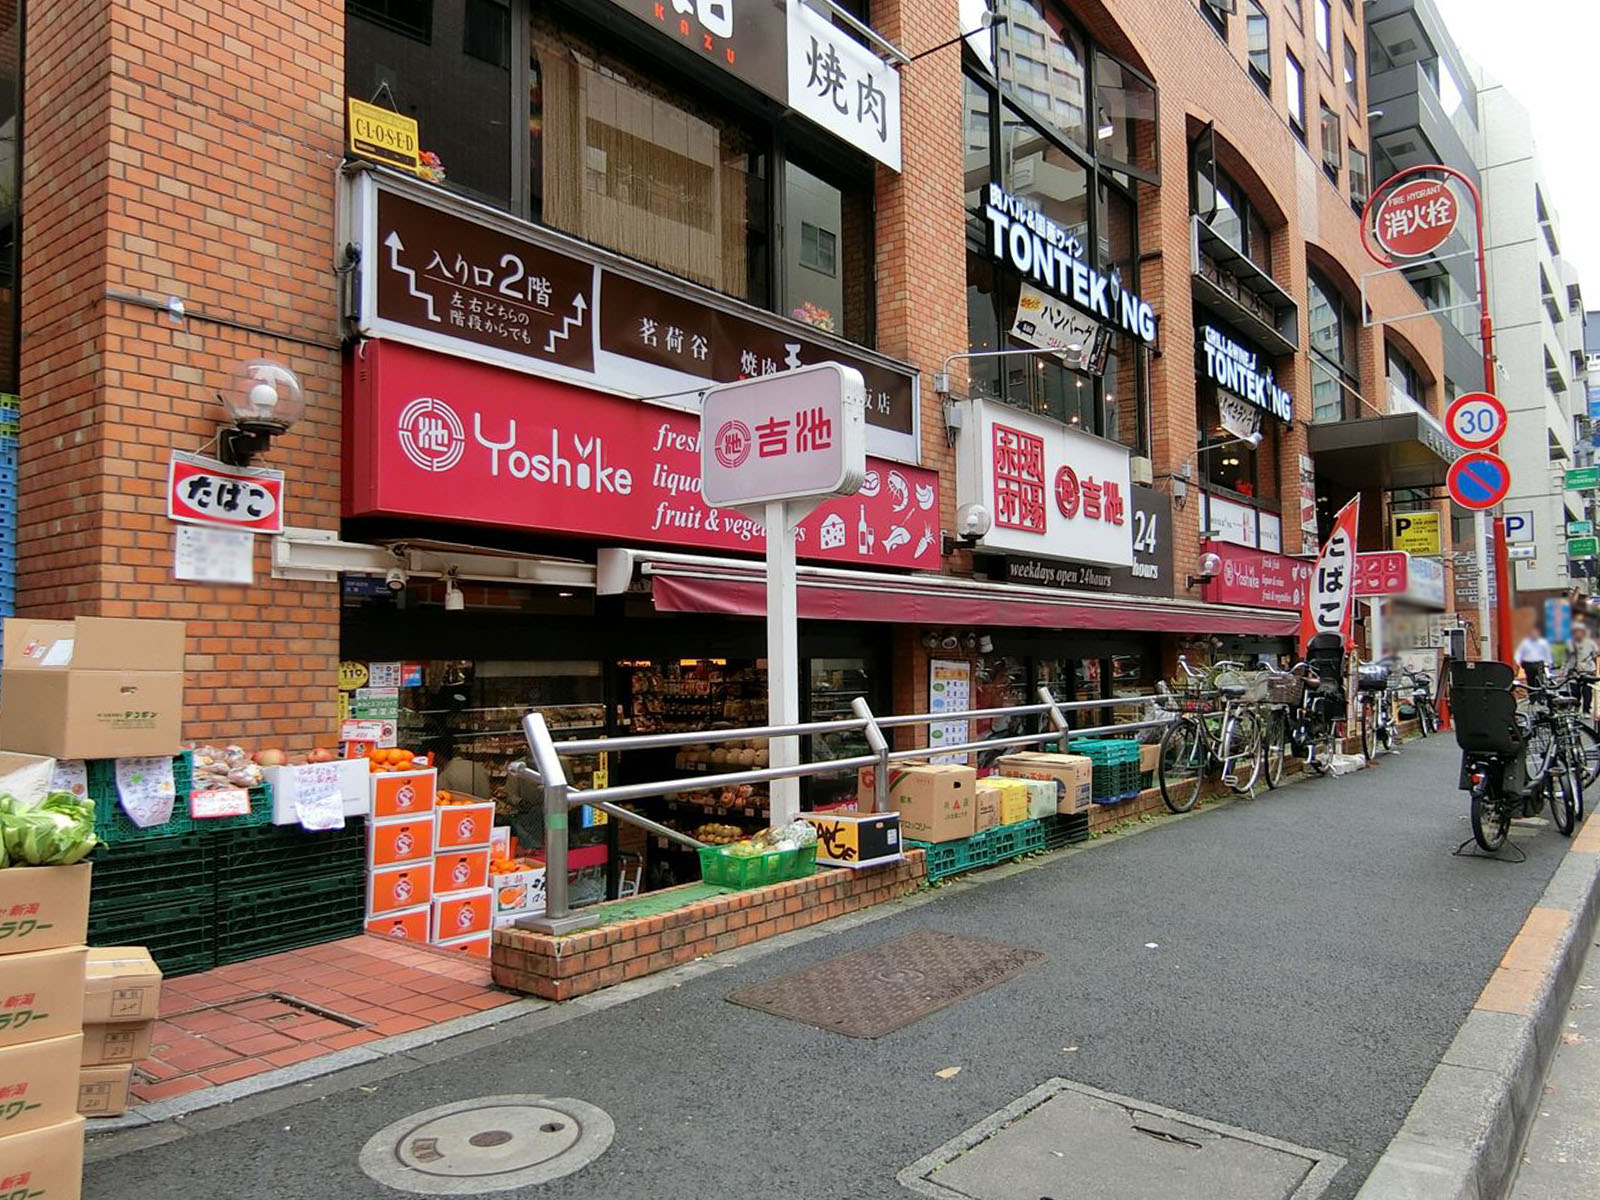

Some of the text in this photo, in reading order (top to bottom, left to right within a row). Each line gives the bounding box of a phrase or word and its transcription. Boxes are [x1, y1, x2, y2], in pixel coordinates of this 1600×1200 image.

[806, 35, 887, 143] 焼肉
[1388, 184, 1441, 207] FIRE HYDRANT
[1384, 197, 1452, 240] 消火栓
[425, 250, 553, 308] 入り口2階
[449, 310, 532, 345] 階段からでも
[450, 291, 530, 325] 左右どちらの
[639, 317, 709, 361] 茗荷谷
[754, 406, 832, 458] 吉池
[1459, 408, 1495, 435] 30
[474, 412, 633, 495] Yoshike
[187, 475, 265, 518] たばこ
[1080, 475, 1124, 527] 吉池
[651, 501, 702, 531] fruit
[704, 508, 719, 532] &
[1134, 509, 1157, 554] 24
[1395, 518, 1412, 537] P
[1506, 516, 1525, 538] P
[1009, 560, 1055, 584] weekdays
[1055, 568, 1077, 587] open
[1132, 556, 1159, 579] hours
